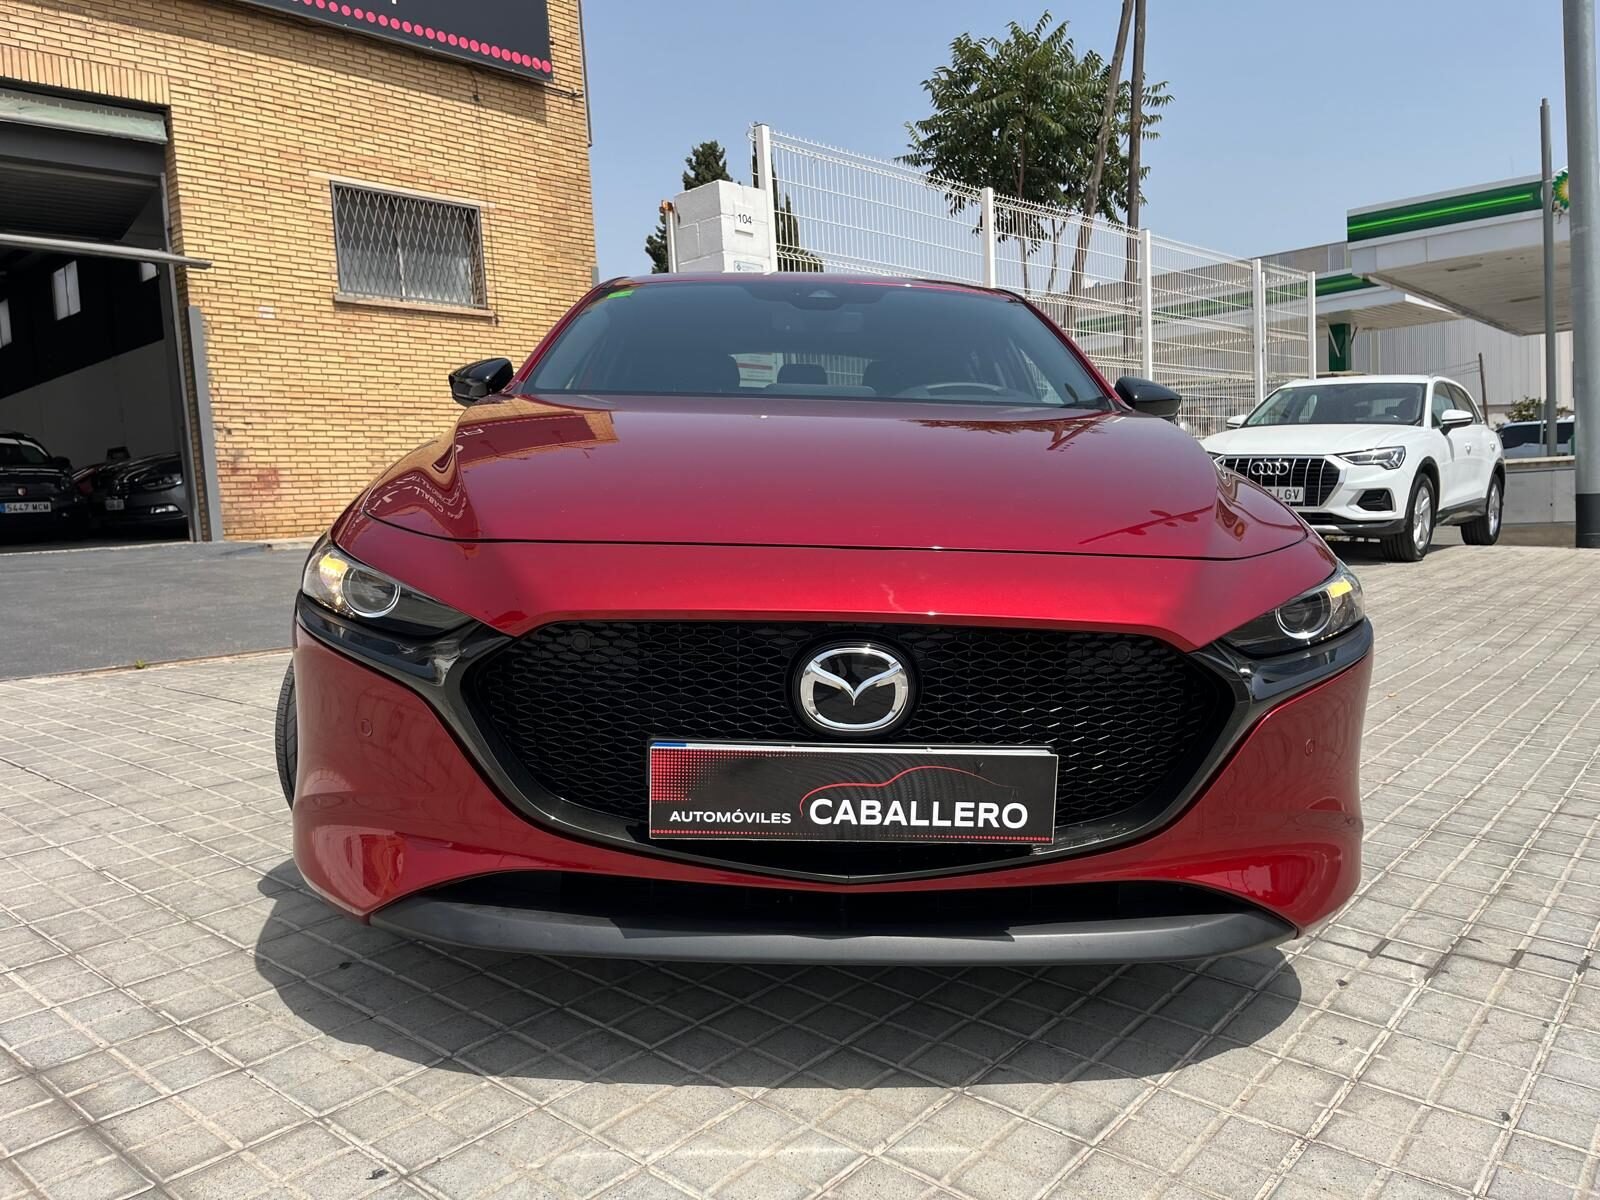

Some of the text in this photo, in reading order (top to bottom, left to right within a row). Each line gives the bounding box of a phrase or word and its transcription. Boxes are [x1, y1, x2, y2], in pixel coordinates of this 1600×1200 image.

[738, 213, 752, 225] 104
[6, 502, 29, 512] 5447
[669, 798, 1029, 829] AUTOMÓVILES CABALLERO
